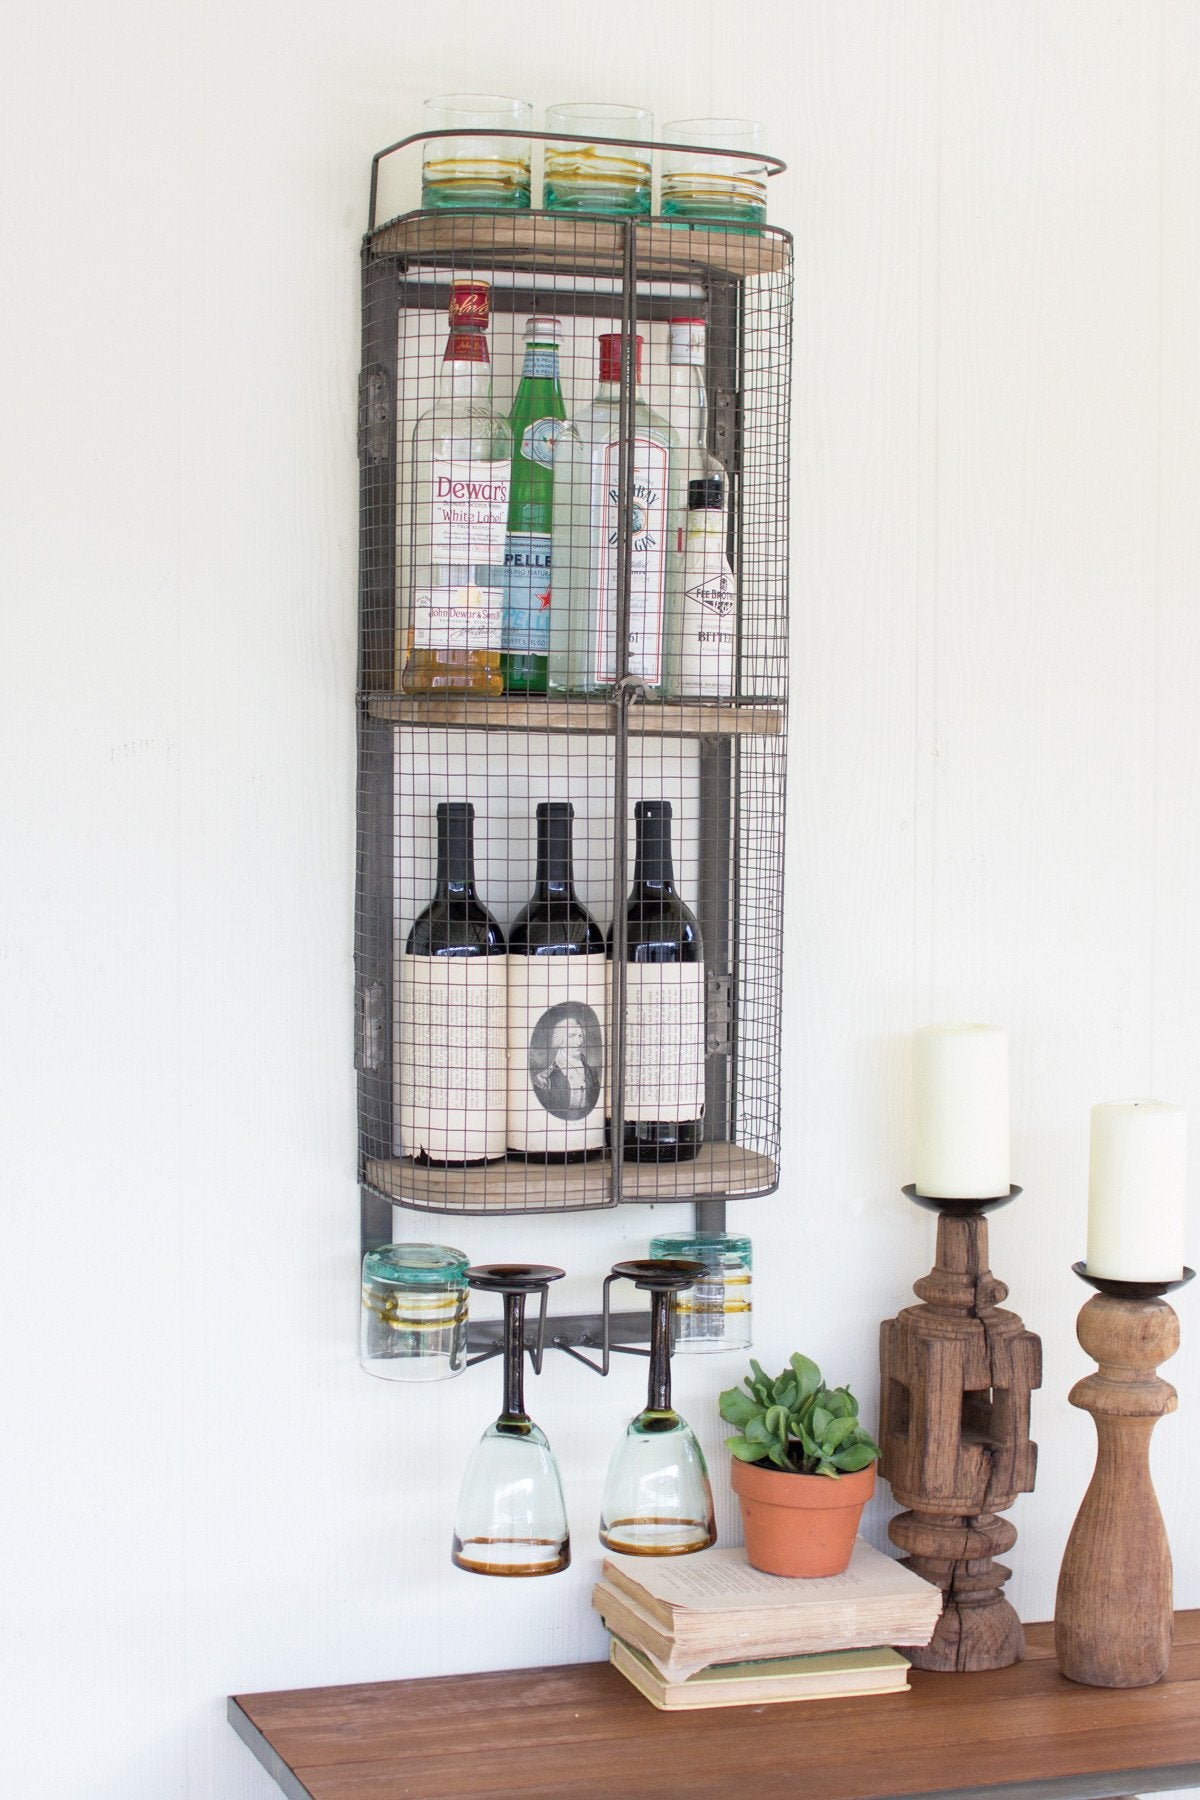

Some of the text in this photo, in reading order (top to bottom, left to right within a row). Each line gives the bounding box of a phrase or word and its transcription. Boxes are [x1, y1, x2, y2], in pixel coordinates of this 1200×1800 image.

[437, 477, 507, 502] Dewar's
[634, 534, 657, 552] GIN
[696, 588, 710, 599] FEE
[448, 608, 476, 619] Dewar
